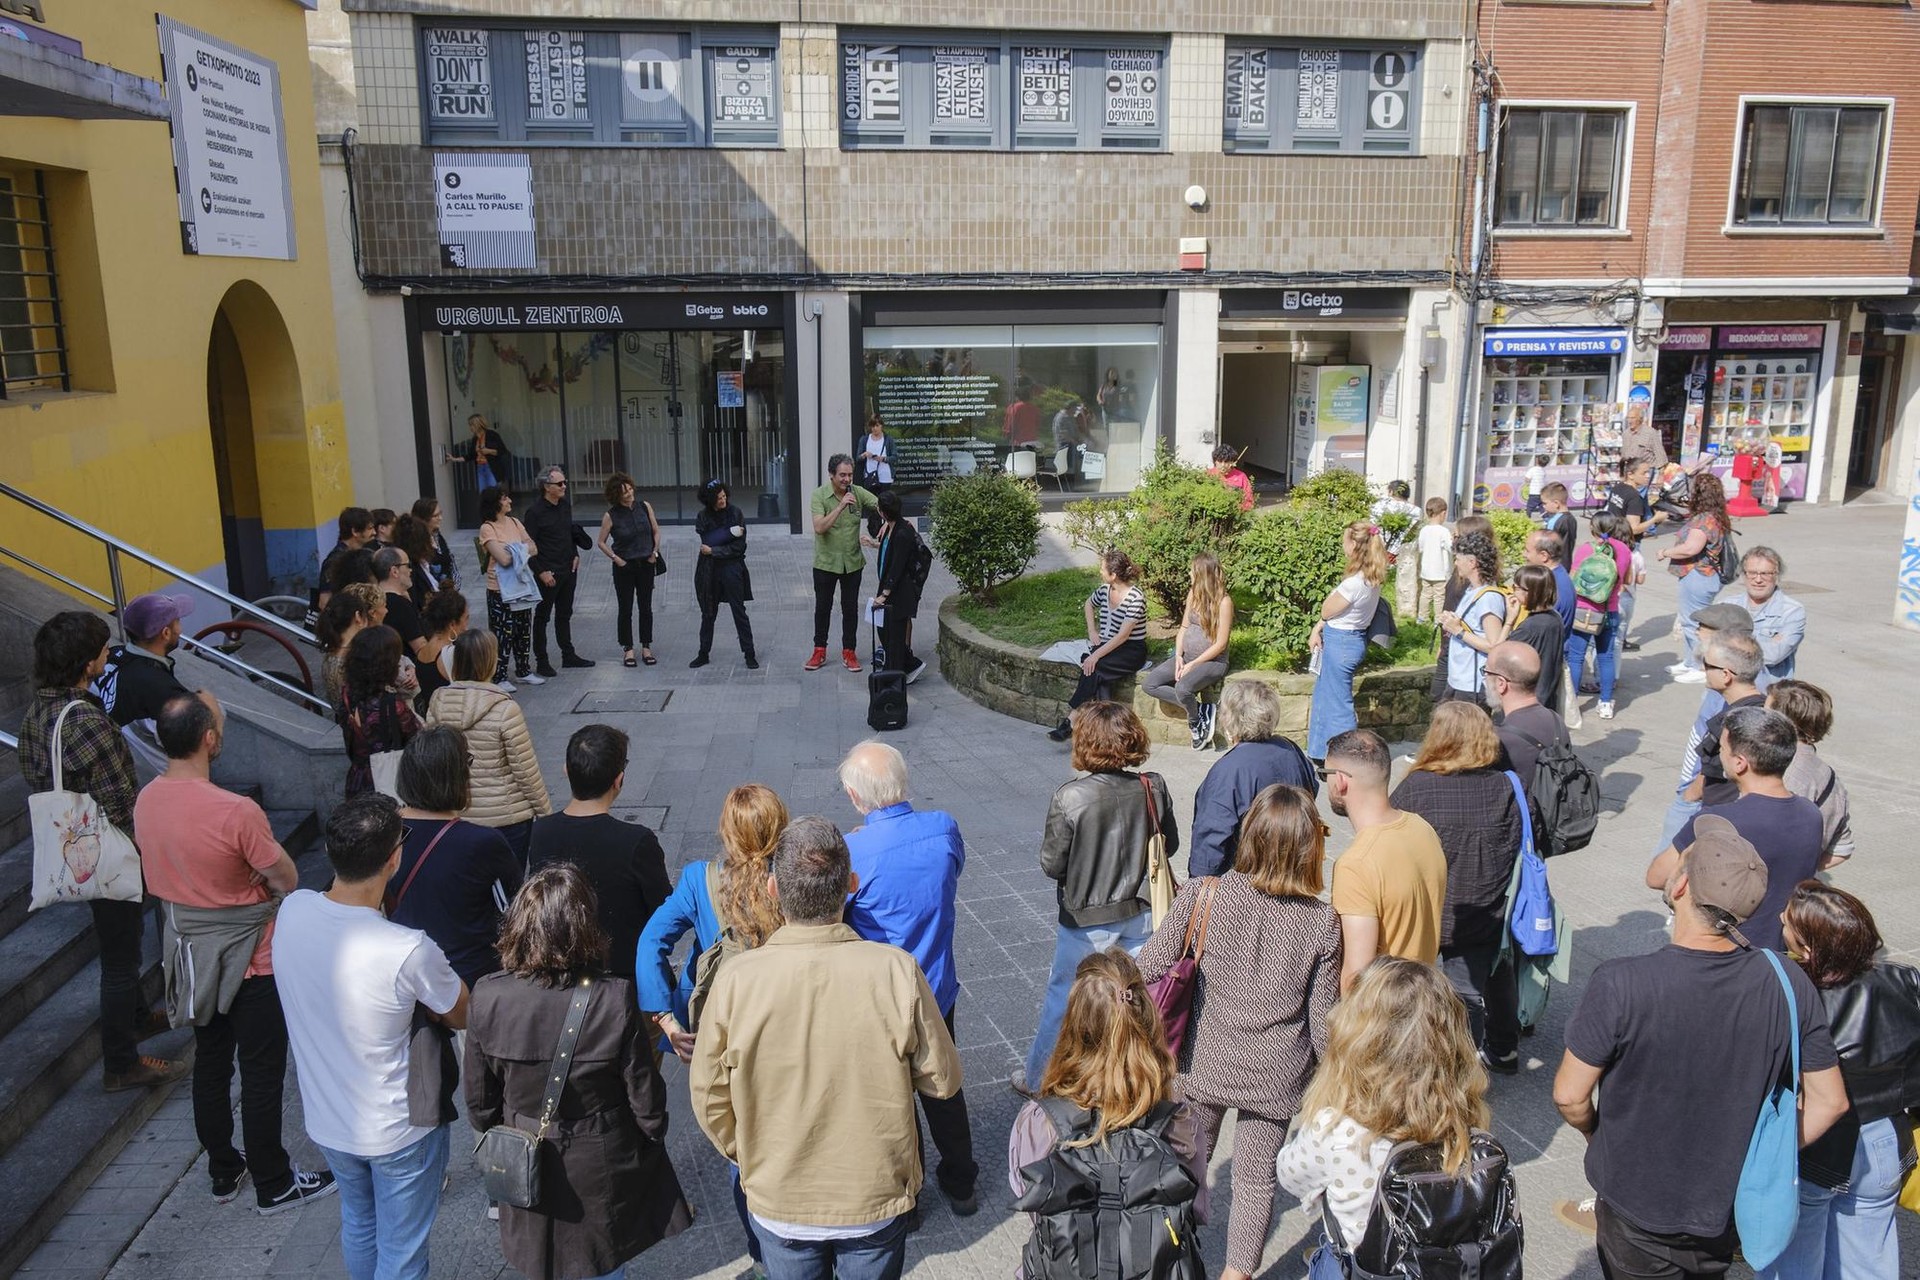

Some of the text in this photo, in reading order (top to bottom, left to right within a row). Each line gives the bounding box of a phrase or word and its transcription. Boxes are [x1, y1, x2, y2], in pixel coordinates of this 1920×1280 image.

[434, 30, 481, 44] WALK
[726, 48, 760, 56] GALDU
[937, 46, 984, 55] GETXOPHOTO
[1024, 47, 1056, 57] BETI
[1109, 50, 1155, 59] GUTXIAGO
[1301, 50, 1337, 61] CHOOSE
[196, 50, 261, 86] GETXOPHOTO 2023
[436, 57, 483, 82] DON'T
[1023, 61, 1057, 74] BETI
[1112, 61, 1152, 71] GEHIAGO
[527, 42, 542, 104] PRESAS
[549, 48, 565, 100] DE LAS
[571, 44, 587, 103] PRISAS
[845, 55, 860, 103] PIERDE EL
[1125, 73, 1138, 83] DA
[866, 45, 899, 120] TREN
[1024, 77, 1056, 89] BETI
[1227, 55, 1244, 118] EMAN
[1250, 50, 1267, 124] BAKEA
[937, 62, 951, 117] PAUSA!
[954, 63, 967, 116] ETENA!
[970, 63, 984, 117] PAUSE!
[1126, 86, 1137, 96] DA
[1299, 63, 1312, 117] EVERYTHING
[1324, 64, 1338, 118] EVERYTHING
[439, 96, 486, 114] RUN
[725, 97, 763, 106] BIZITZA
[1111, 98, 1151, 109] GEHIAGO
[724, 106, 765, 115] IRABAZI
[1109, 110, 1154, 121] GUTXIAGO
[203, 108, 227, 122] COCINANDO
[229, 116, 249, 130] HISTORIAS
[449, 176, 457, 185] 3
[214, 205, 241, 217] Exposiciones
[1301, 292, 1343, 307] Getxo
[436, 306, 623, 325] URGULL ZENTROA
[697, 305, 723, 315] Getxo
[733, 305, 758, 315] bbk
[1729, 331, 1780, 343] IBEROAMÉRICA
[1507, 341, 1606, 352] PRENSA Y REVISTAS
